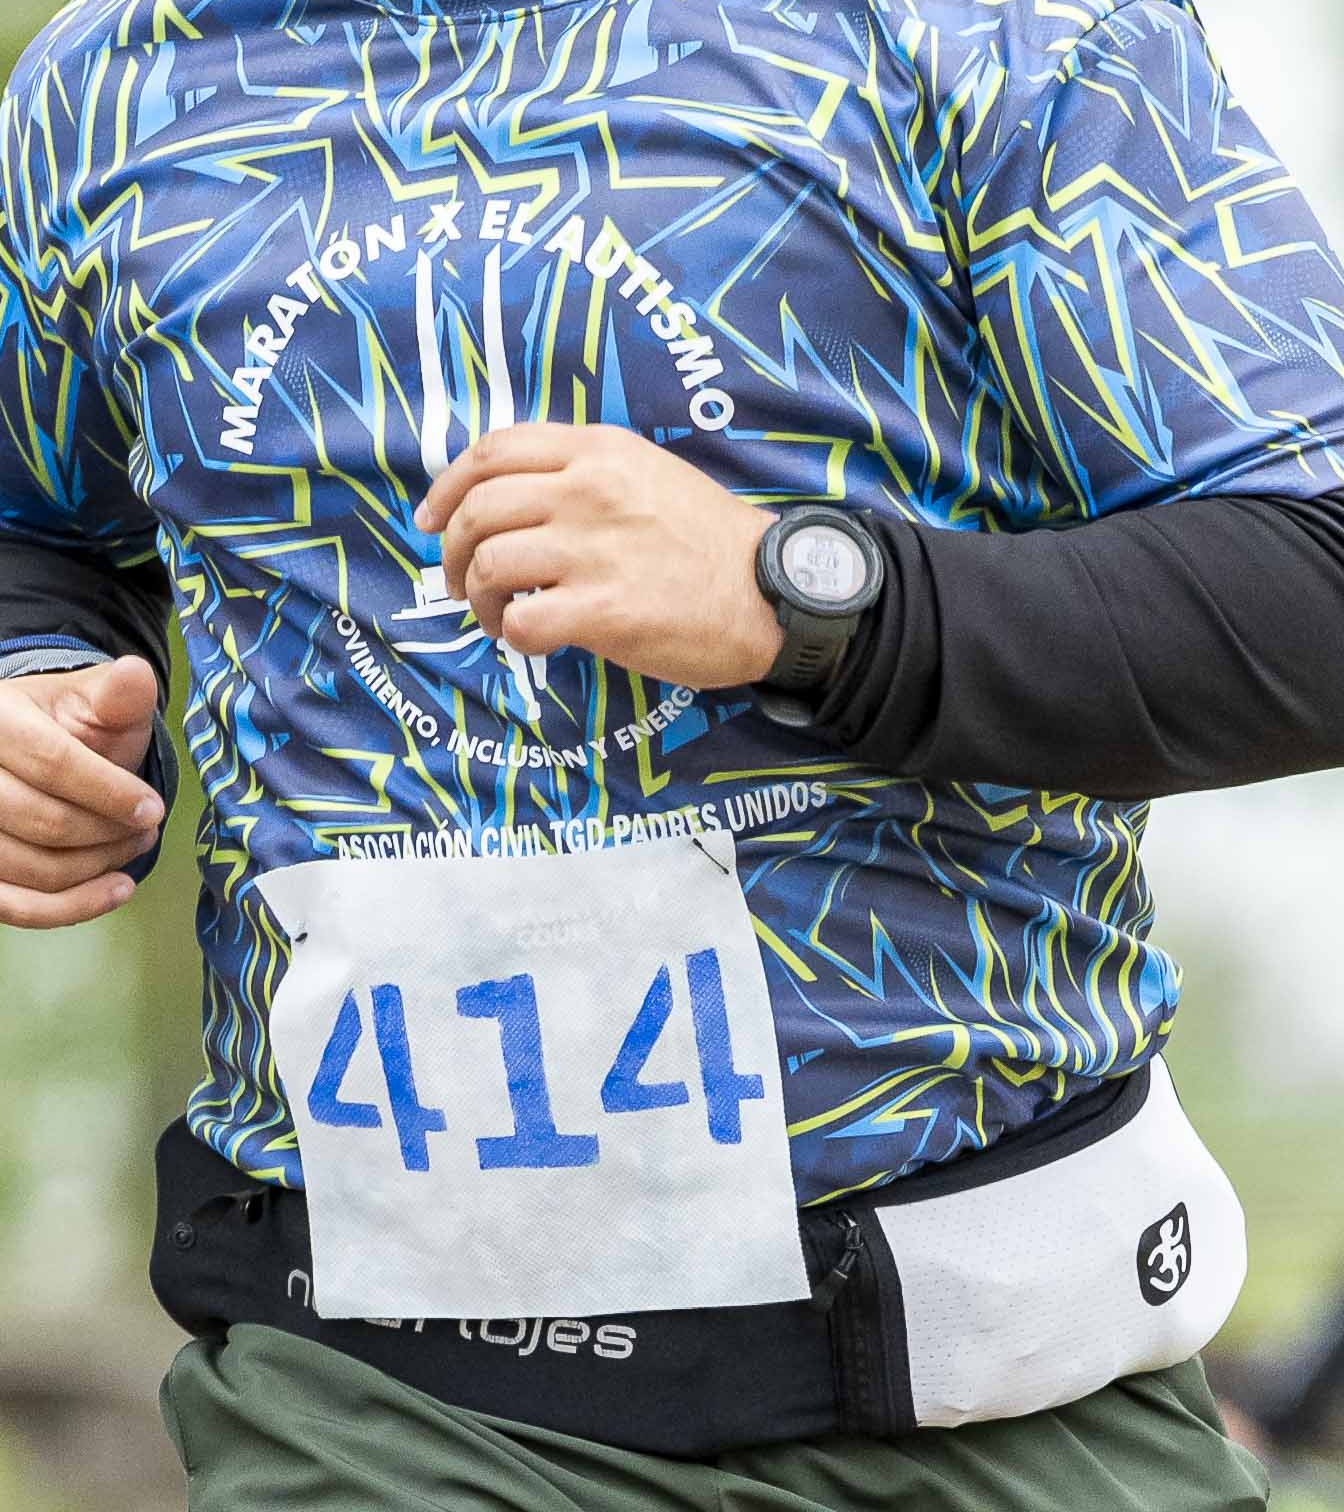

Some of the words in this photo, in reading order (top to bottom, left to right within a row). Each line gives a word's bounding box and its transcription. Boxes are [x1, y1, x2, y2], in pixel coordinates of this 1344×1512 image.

[220, 215, 406, 456] MARATÓN
[424, 201, 465, 243] X
[478, 199, 534, 245] EL
[543, 214, 735, 432] AUTISMO
[328, 605, 441, 748] OVIMIENTO,
[588, 736, 608, 759] Y
[337, 819, 473, 861] ASOCIACIÓN
[480, 823, 548, 857] CIVIL
[549, 818, 605, 857] TGD
[612, 804, 723, 847] PADRES
[724, 781, 827, 832] UNIDOS
[308, 949, 765, 1171] 414
